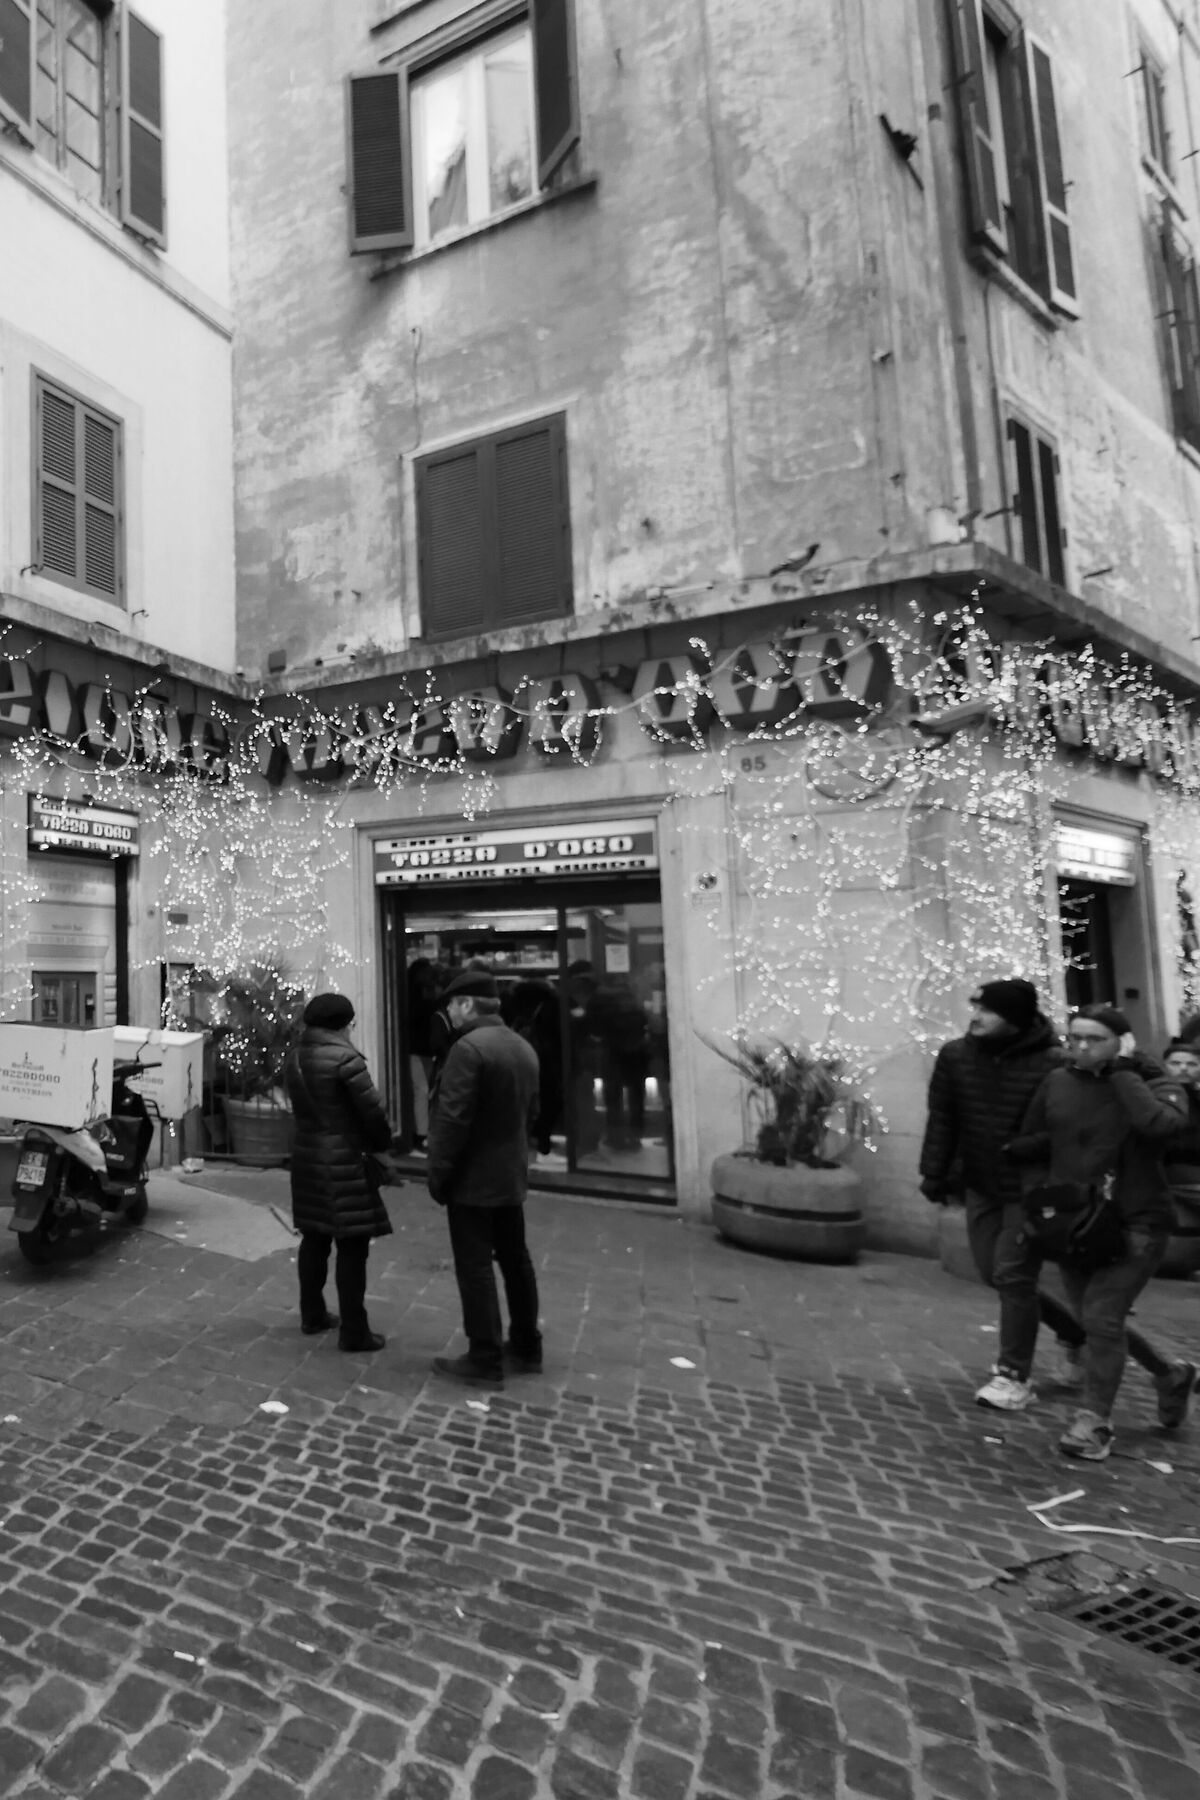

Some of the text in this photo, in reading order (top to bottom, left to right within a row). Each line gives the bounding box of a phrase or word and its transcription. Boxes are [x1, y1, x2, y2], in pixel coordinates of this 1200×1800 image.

[390, 836, 633, 867] TAZZA D'ORO
[416, 868, 497, 881] MEJOR
[505, 865, 548, 876] DEL
[555, 858, 646, 873] MUNDO
